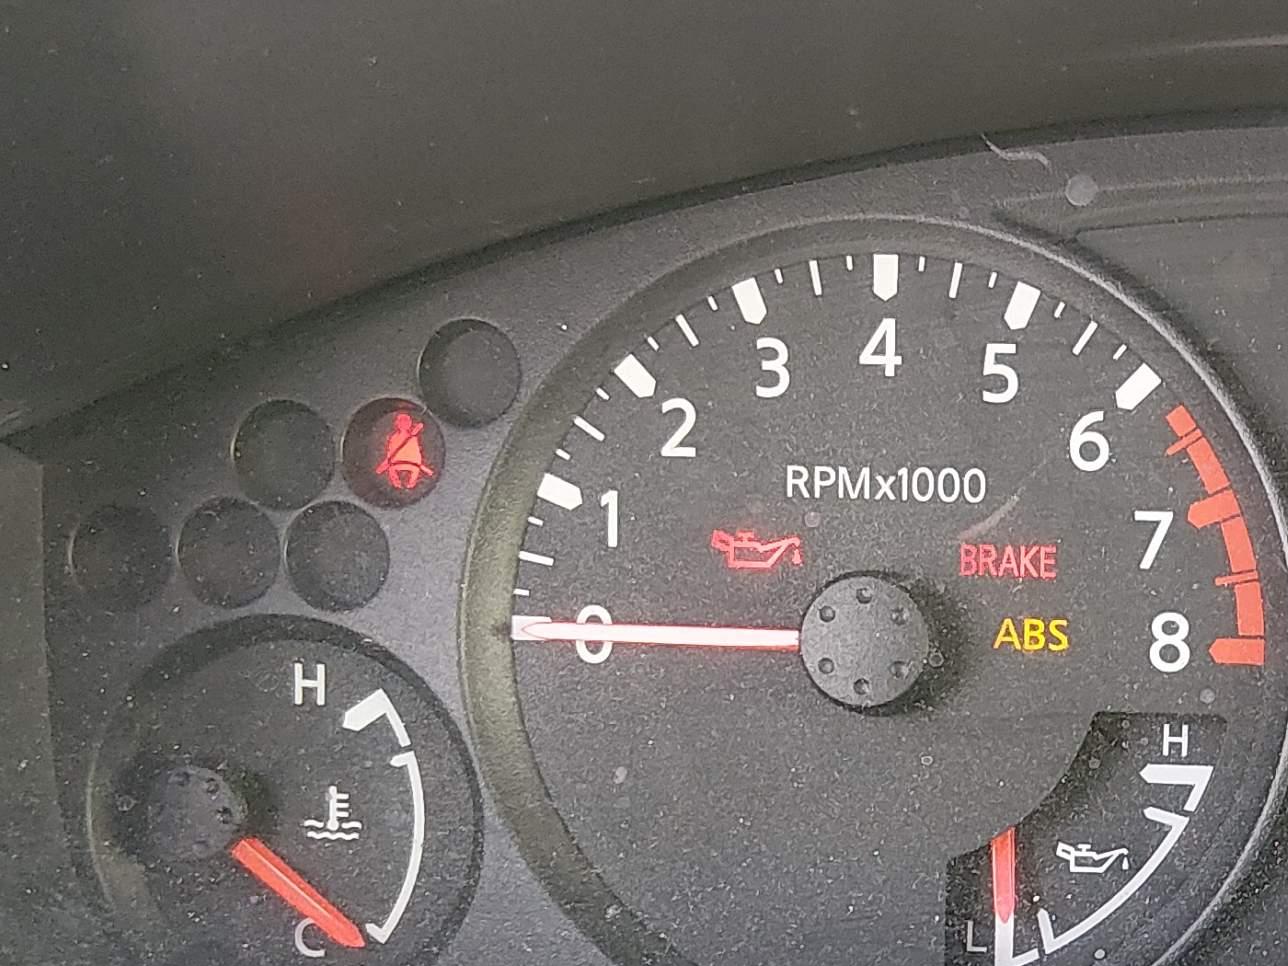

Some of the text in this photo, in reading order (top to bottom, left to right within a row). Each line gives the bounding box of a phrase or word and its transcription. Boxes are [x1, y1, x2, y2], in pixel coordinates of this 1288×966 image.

[755, 337, 790, 397] 3
[859, 318, 901, 377] 4
[982, 343, 1018, 402] 5
[661, 398, 697, 457] 2
[1069, 411, 1109, 471] 6
[786, 464, 987, 504] RPMx1000
[600, 490, 618, 548] 1
[1133, 510, 1174, 569] 7
[959, 544, 1057, 578] BRAKE
[576, 605, 613, 664] 0
[994, 618, 1069, 651] ABS
[1149, 611, 1191, 672] 8
[294, 662, 325, 705] H
[1163, 723, 1189, 757] H
[295, 917, 326, 957] C
[966, 919, 987, 953] L
